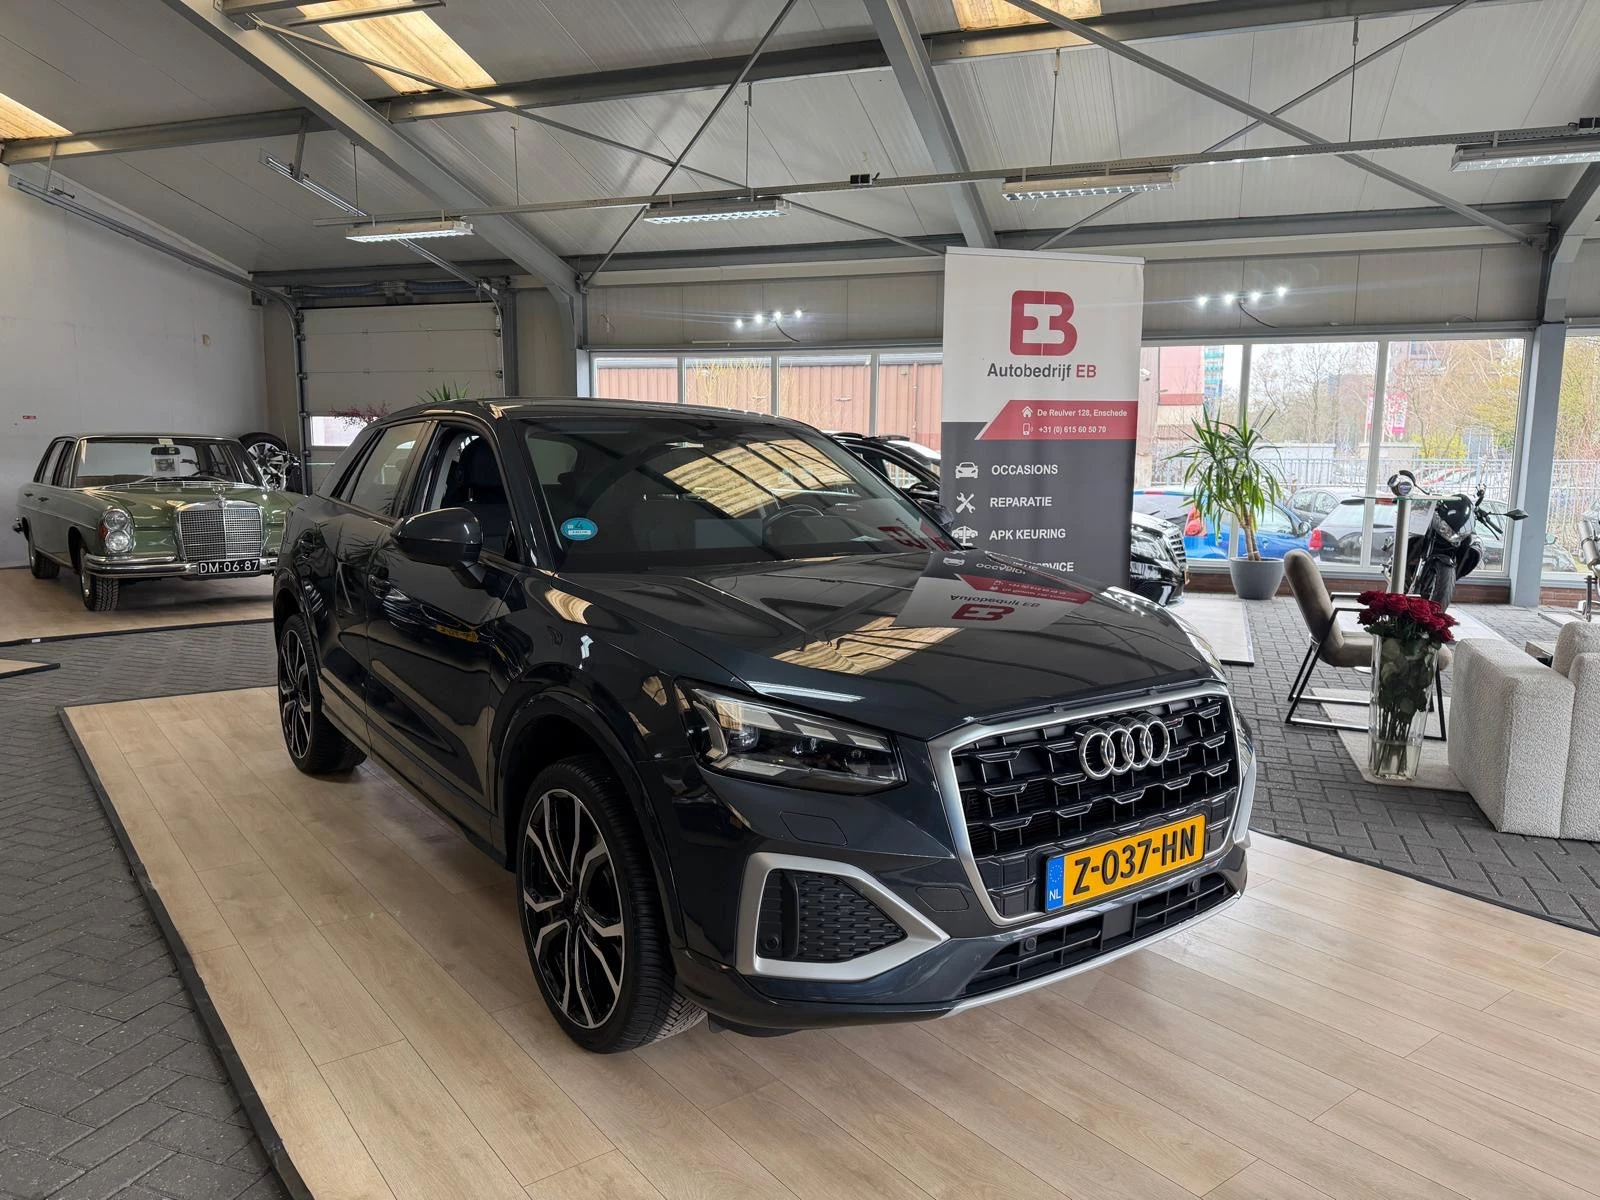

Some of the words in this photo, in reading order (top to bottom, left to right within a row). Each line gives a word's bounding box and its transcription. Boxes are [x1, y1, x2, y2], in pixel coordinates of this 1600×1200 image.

[987, 362, 1071, 381] Autobedrijf
[1075, 364, 1097, 378] EB
[1037, 409, 1047, 417] De
[1078, 409, 1092, 417] 128,
[1094, 409, 1128, 417] Enschede
[1053, 426, 1063, 434] (0)
[991, 464, 1058, 475] OCCASIONS
[989, 496, 1053, 508] REPARATIE
[989, 530, 1013, 541] APK
[1016, 528, 1066, 540] KEURING
[199, 560, 259, 574] DM-06-87
[1072, 825, 1196, 896] Z-037-HN
[1049, 888, 1061, 902] NL
